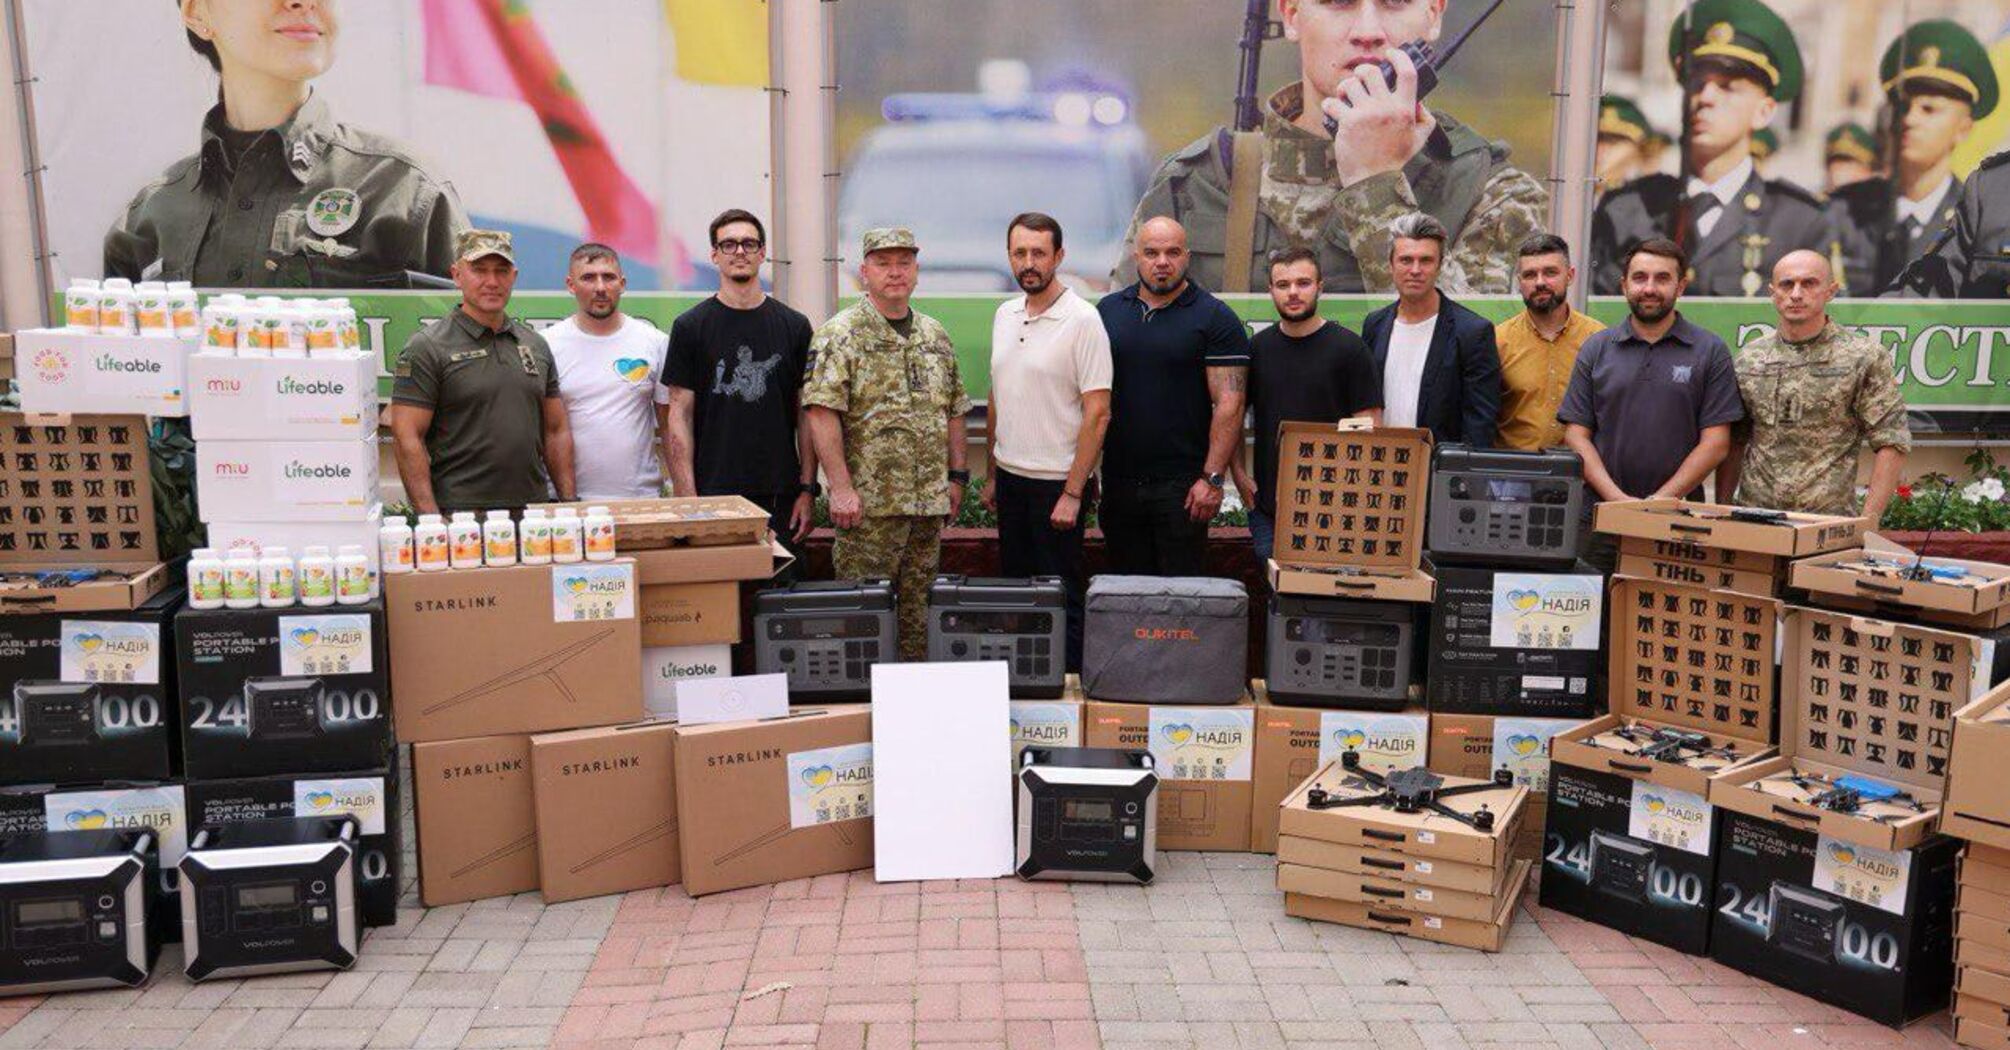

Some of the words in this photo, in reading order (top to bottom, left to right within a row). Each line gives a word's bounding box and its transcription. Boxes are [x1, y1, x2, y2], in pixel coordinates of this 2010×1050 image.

[96, 353, 161, 373] Lifeable
[276, 376, 344, 394] Lifeable
[284, 460, 351, 478] Lifeable
[1653, 540, 1707, 560] ТІНЬ
[1653, 561, 1706, 583] ТІНЬ
[589, 580, 626, 592] НАДІЯ
[414, 595, 497, 612] STARLINK
[1542, 598, 1591, 613] НАДІЯ
[321, 632, 362, 645] НАДІЯ
[1135, 628, 1199, 640] OUKITEL
[0, 640, 37, 648] ABLE
[106, 641, 149, 652] НАДІЯ
[193, 637, 266, 648] PORTABLE
[193, 646, 256, 655] STATION
[661, 662, 717, 678] Lifeable
[1022, 726, 1069, 739] НАДІЯ
[1196, 732, 1242, 744] НАДІЯ
[1368, 738, 1415, 751] НАДІЯ
[707, 748, 782, 767] STARLINK
[443, 759, 523, 779] STARLINK
[562, 756, 640, 775] STARLINK
[836, 767, 874, 782] НАДІ
[1557, 788, 1605, 807] STATION
[1558, 782, 1615, 803] PORTABLE
[205, 803, 278, 815] PORTABLE
[336, 796, 376, 807] НАДІЯ
[0, 815, 47, 825] ORTAB
[112, 813, 171, 829] НАДІЯ
[205, 812, 265, 823] STATION
[1667, 807, 1704, 822] НАДІЯ
[0, 823, 47, 833] TATIO
[1733, 835, 1787, 857] STATION
[1734, 827, 1799, 851] PORTABLE
[1857, 857, 1900, 879] НАДІЯ
